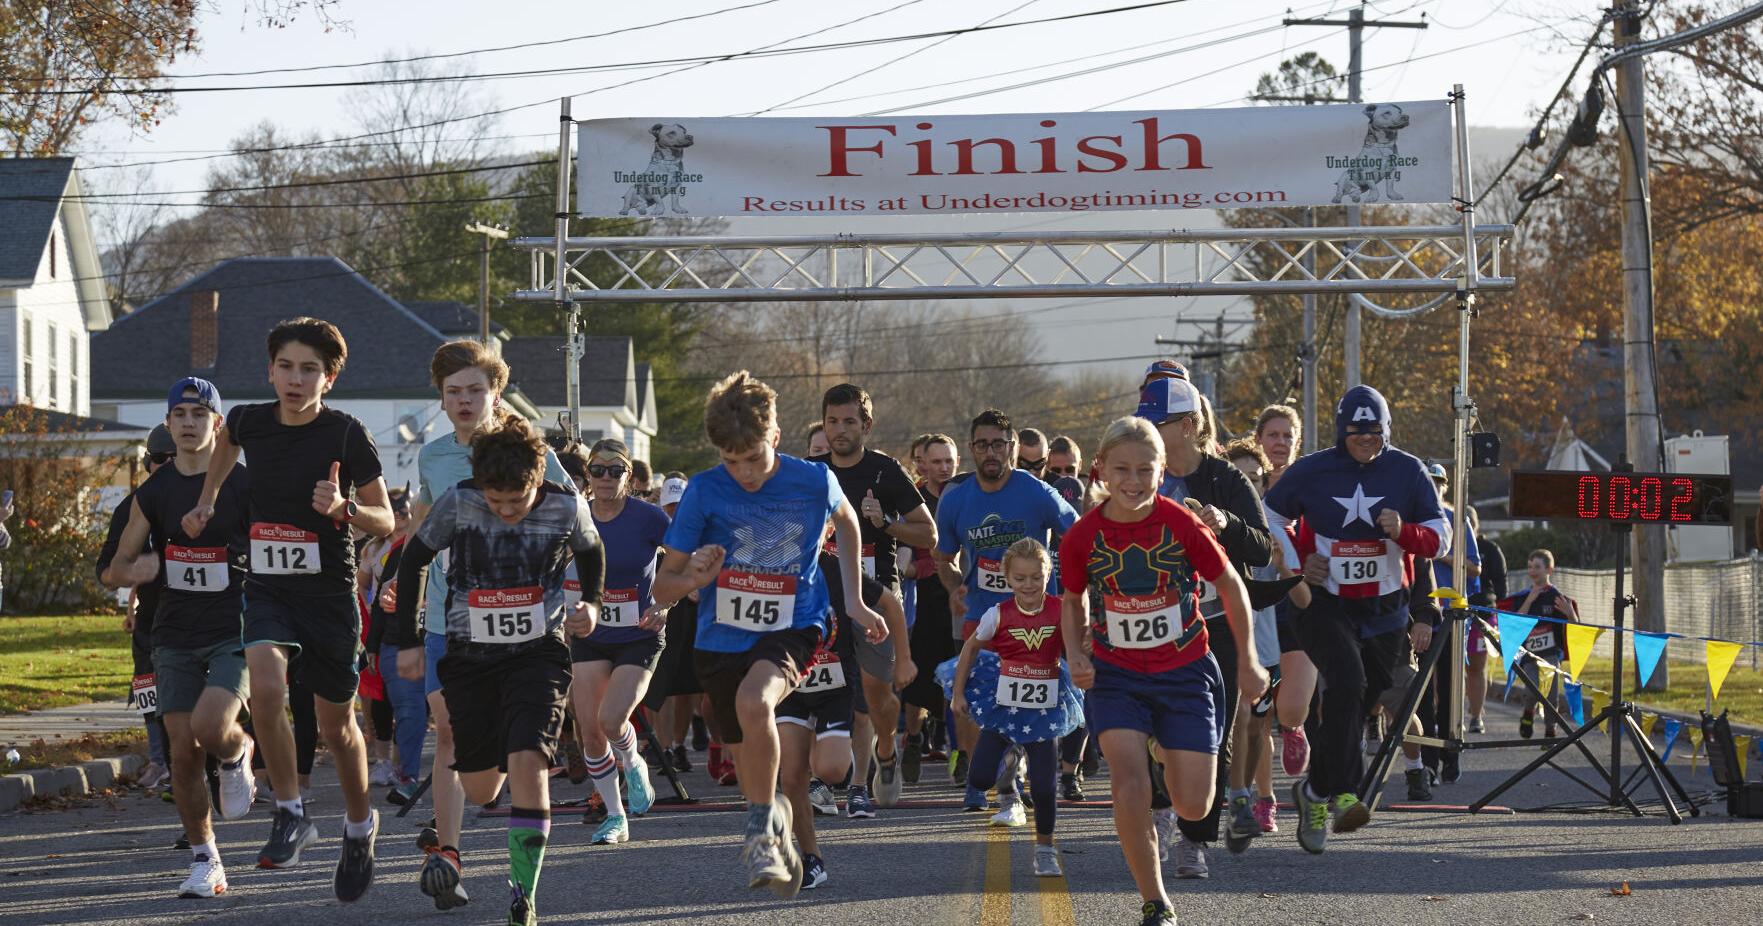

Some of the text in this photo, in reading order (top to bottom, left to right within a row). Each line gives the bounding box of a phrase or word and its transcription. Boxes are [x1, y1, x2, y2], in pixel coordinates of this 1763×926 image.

[815, 117, 1213, 177] Finish
[1326, 154, 1418, 170] Underdog Race
[614, 171, 703, 185] Underdog Race
[1347, 169, 1401, 182] Timing
[634, 184, 686, 196] Timing
[741, 189, 1287, 212] Results at Underdogtiming.com
[1578, 475, 1693, 521] 00:02
[259, 528, 275, 537] RACE
[282, 530, 305, 538] RESULT
[967, 525, 996, 541] NATE
[263, 545, 307, 569] 112
[183, 567, 207, 587] 41
[729, 562, 801, 576] ARMOUR
[1341, 560, 1377, 580] 130
[729, 576, 748, 587] RACE
[757, 580, 784, 590] RESULT
[985, 574, 1013, 590] 25
[478, 595, 497, 604] RACE
[506, 593, 533, 602] RESULT
[1114, 600, 1131, 610] RACE
[1137, 596, 1167, 609] RESULT
[730, 596, 780, 626] 145
[482, 612, 533, 637] 155
[1118, 614, 1169, 643] 126
[797, 667, 833, 689] 24
[1008, 666, 1024, 674] RACE
[1030, 669, 1050, 677] RESULT
[1009, 681, 1048, 704] 123
